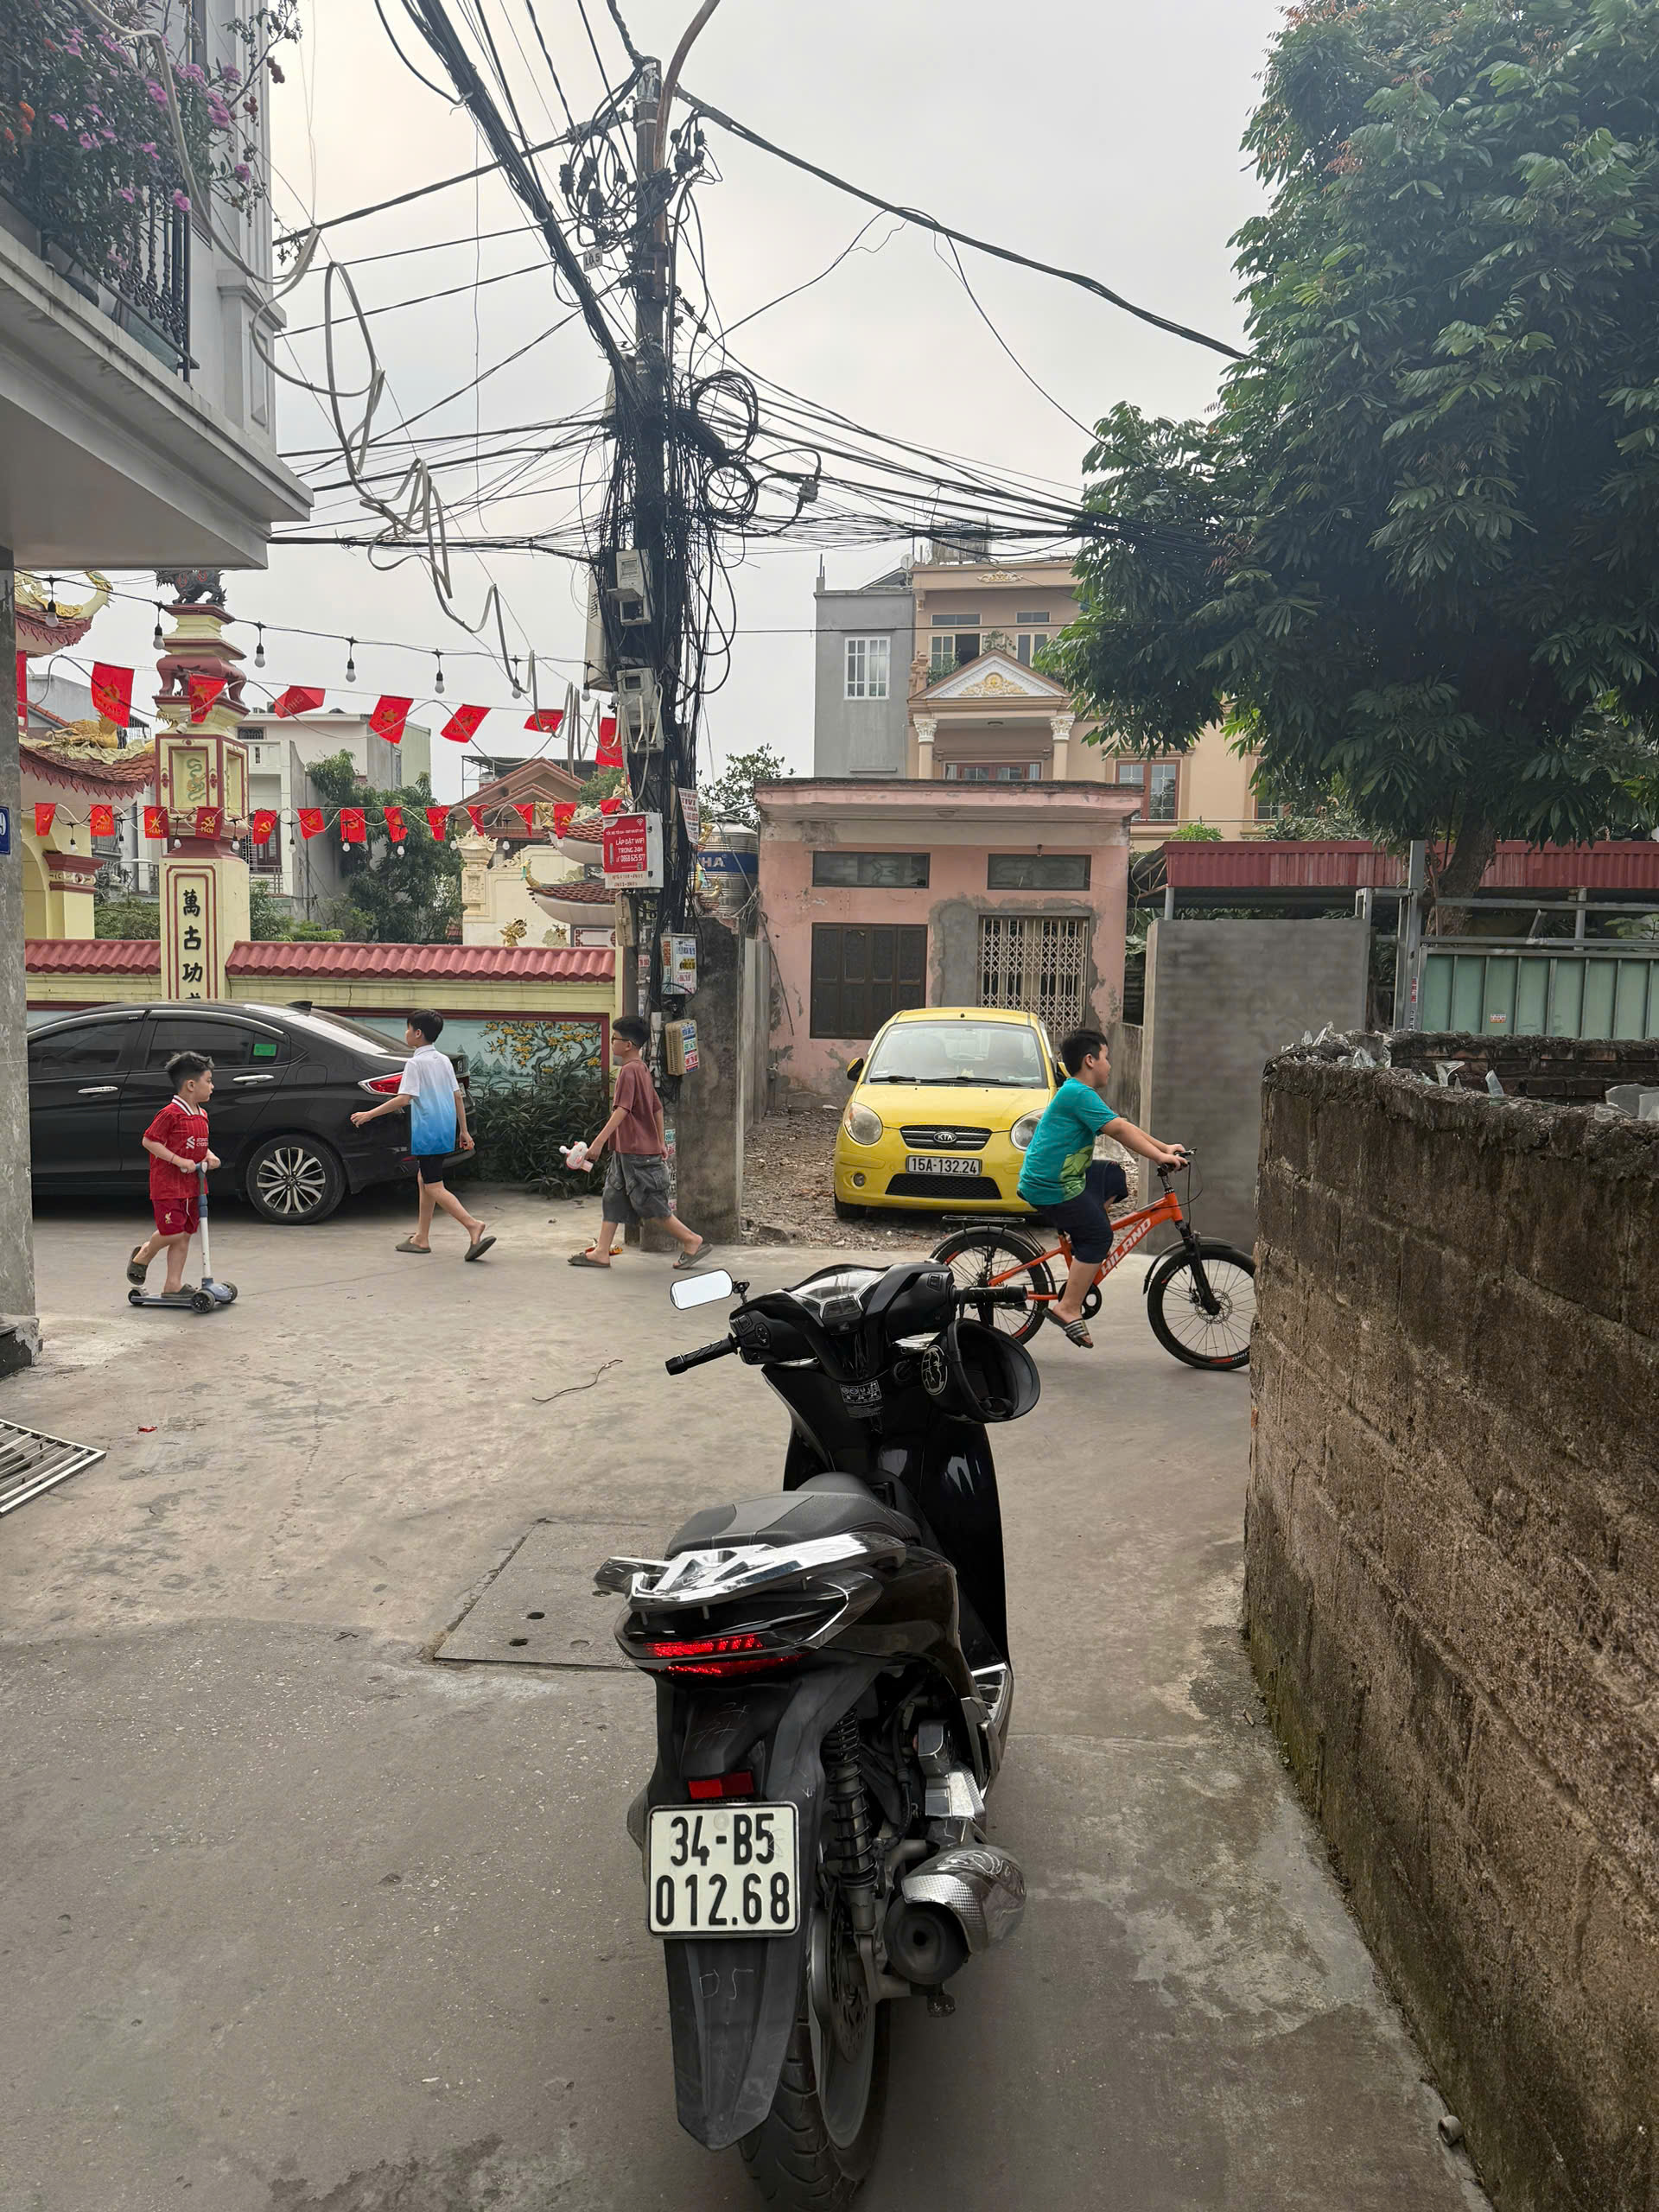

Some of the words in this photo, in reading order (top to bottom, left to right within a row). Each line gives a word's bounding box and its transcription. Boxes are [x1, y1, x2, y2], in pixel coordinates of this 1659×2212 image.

[595, 252, 601, 263] 5
[181, 888, 203, 1000] 萬古功
[912, 1158, 976, 1174] 15A-132.24
[1101, 1217, 1151, 1276] HILAND
[670, 1813, 774, 1866] 34-B5
[656, 1872, 790, 1926] 012.68
